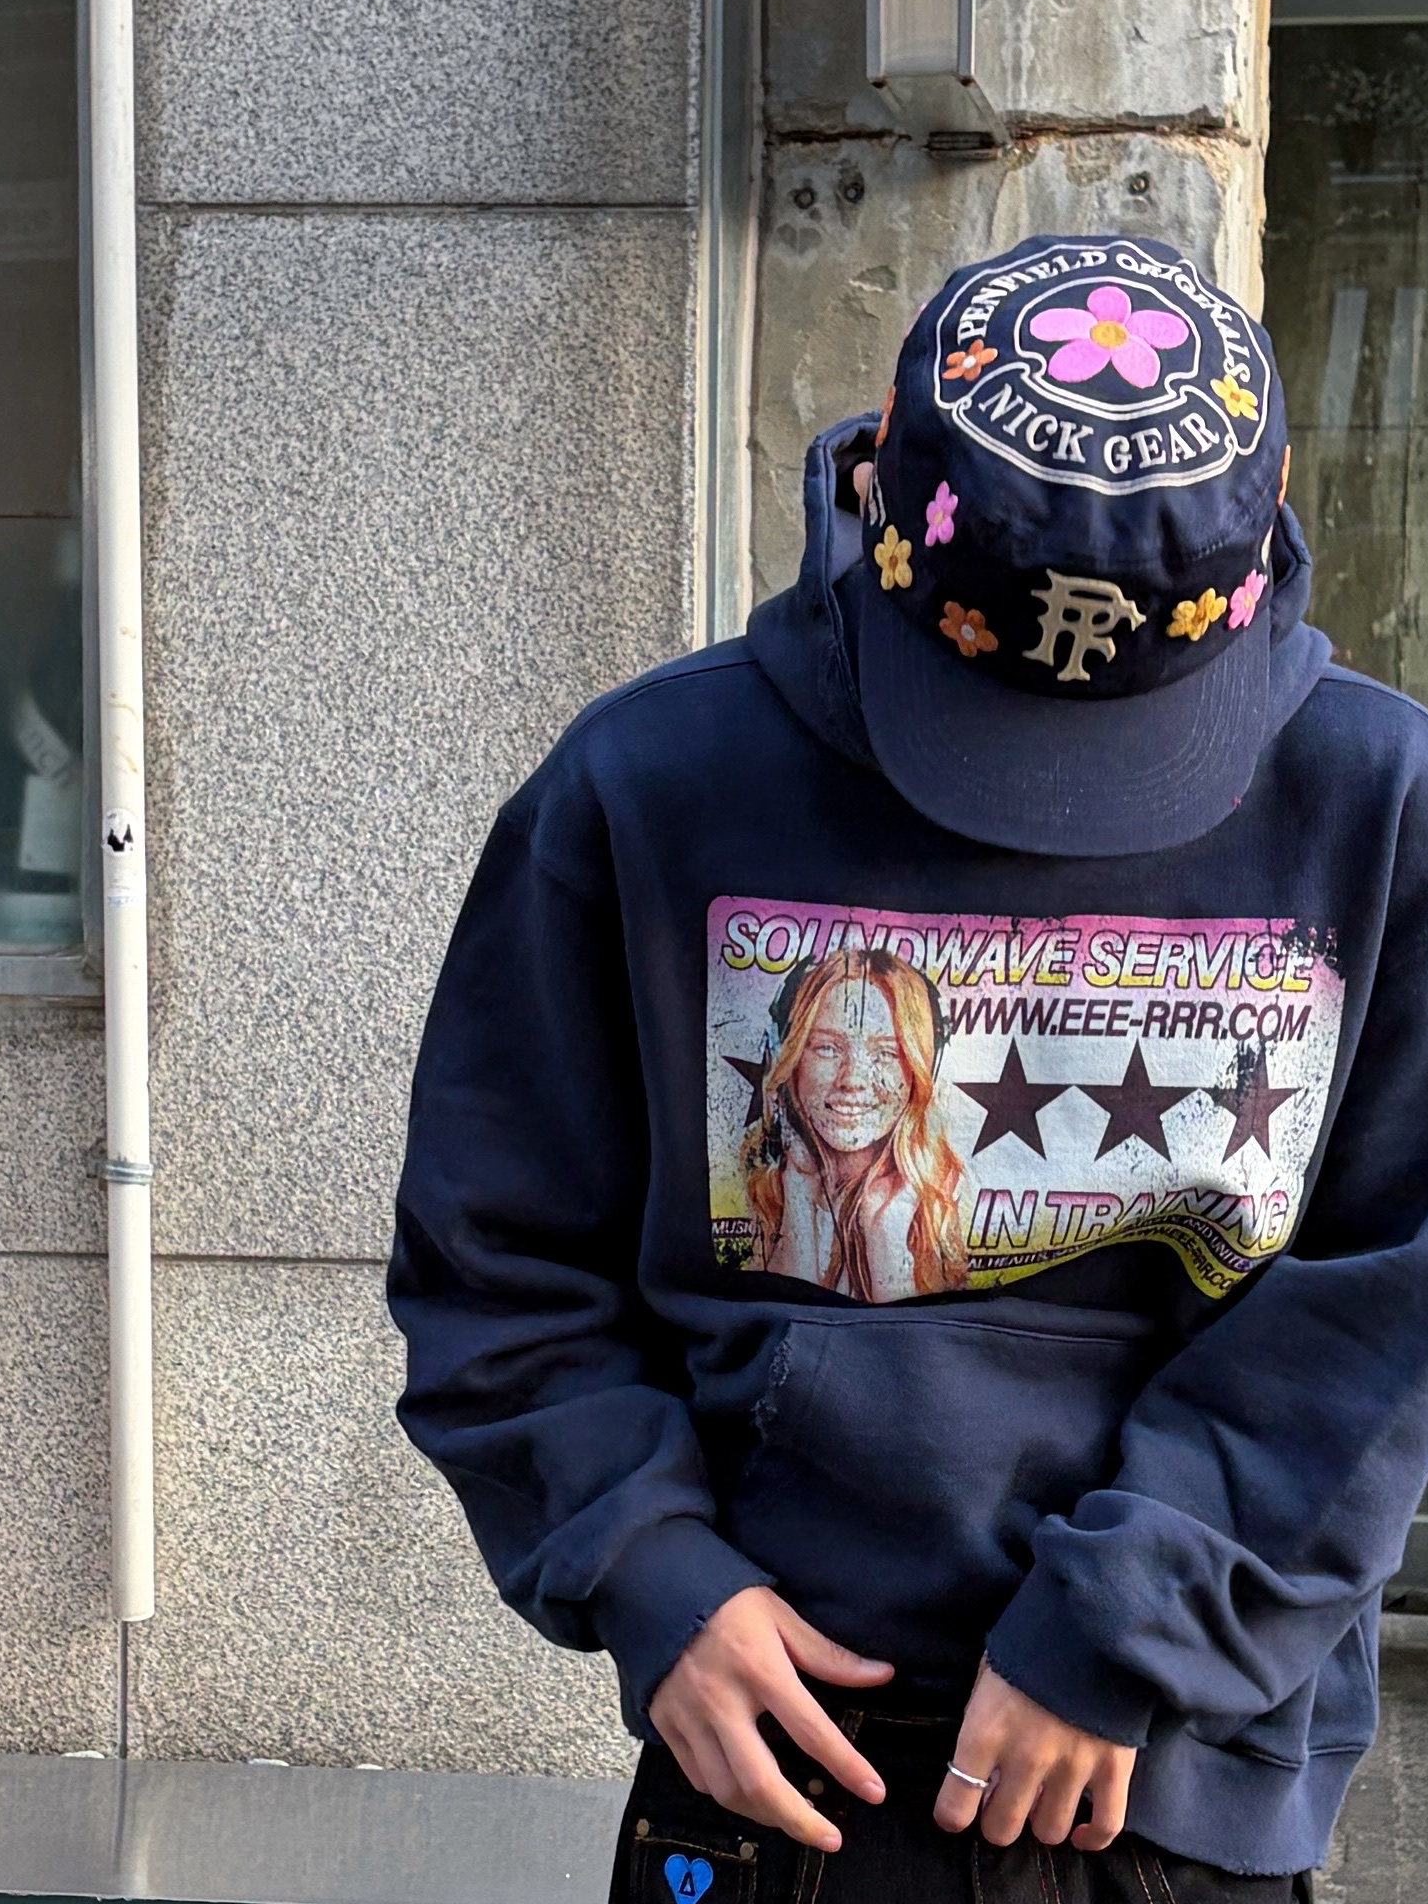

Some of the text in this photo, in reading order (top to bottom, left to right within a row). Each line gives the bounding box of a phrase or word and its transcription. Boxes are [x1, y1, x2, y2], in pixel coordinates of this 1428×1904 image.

[958, 249, 1251, 385] PENFIELD ORIGINALS
[978, 382, 1221, 474] NICK GEAR
[721, 910, 1315, 993] SOUNDWAVE SERVICE
[949, 998, 1312, 1042] WWW.EEE-RRR.COM
[967, 1186, 1038, 1249] IN
[1045, 1186, 1291, 1251] TRAINING
